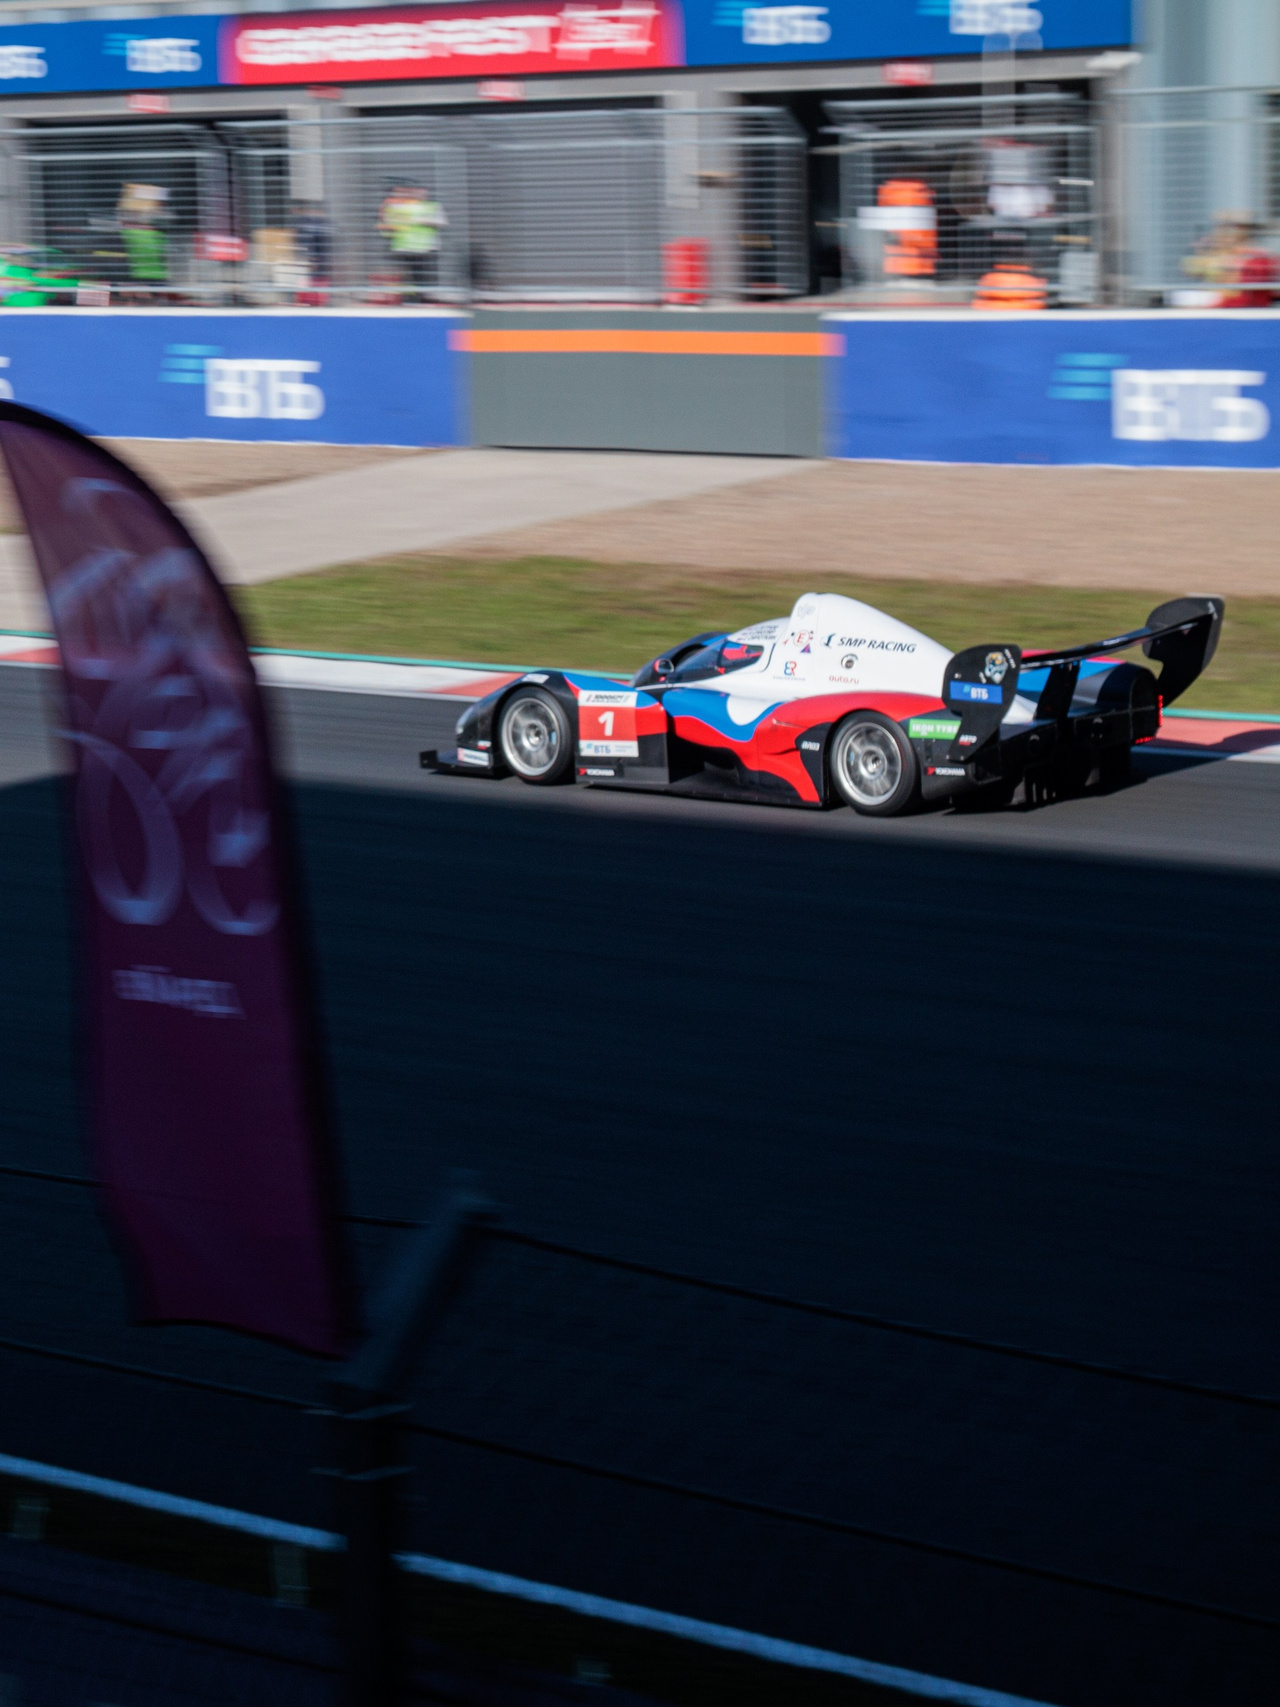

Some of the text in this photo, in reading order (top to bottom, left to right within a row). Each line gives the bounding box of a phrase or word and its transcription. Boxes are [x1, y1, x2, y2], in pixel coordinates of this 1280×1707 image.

[838, 636, 917, 653] SMP RACING
[829, 675, 860, 685] auto.ru
[970, 687, 988, 699] ВТБ
[598, 711, 614, 736] 1
[594, 745, 611, 753] ВТБ
